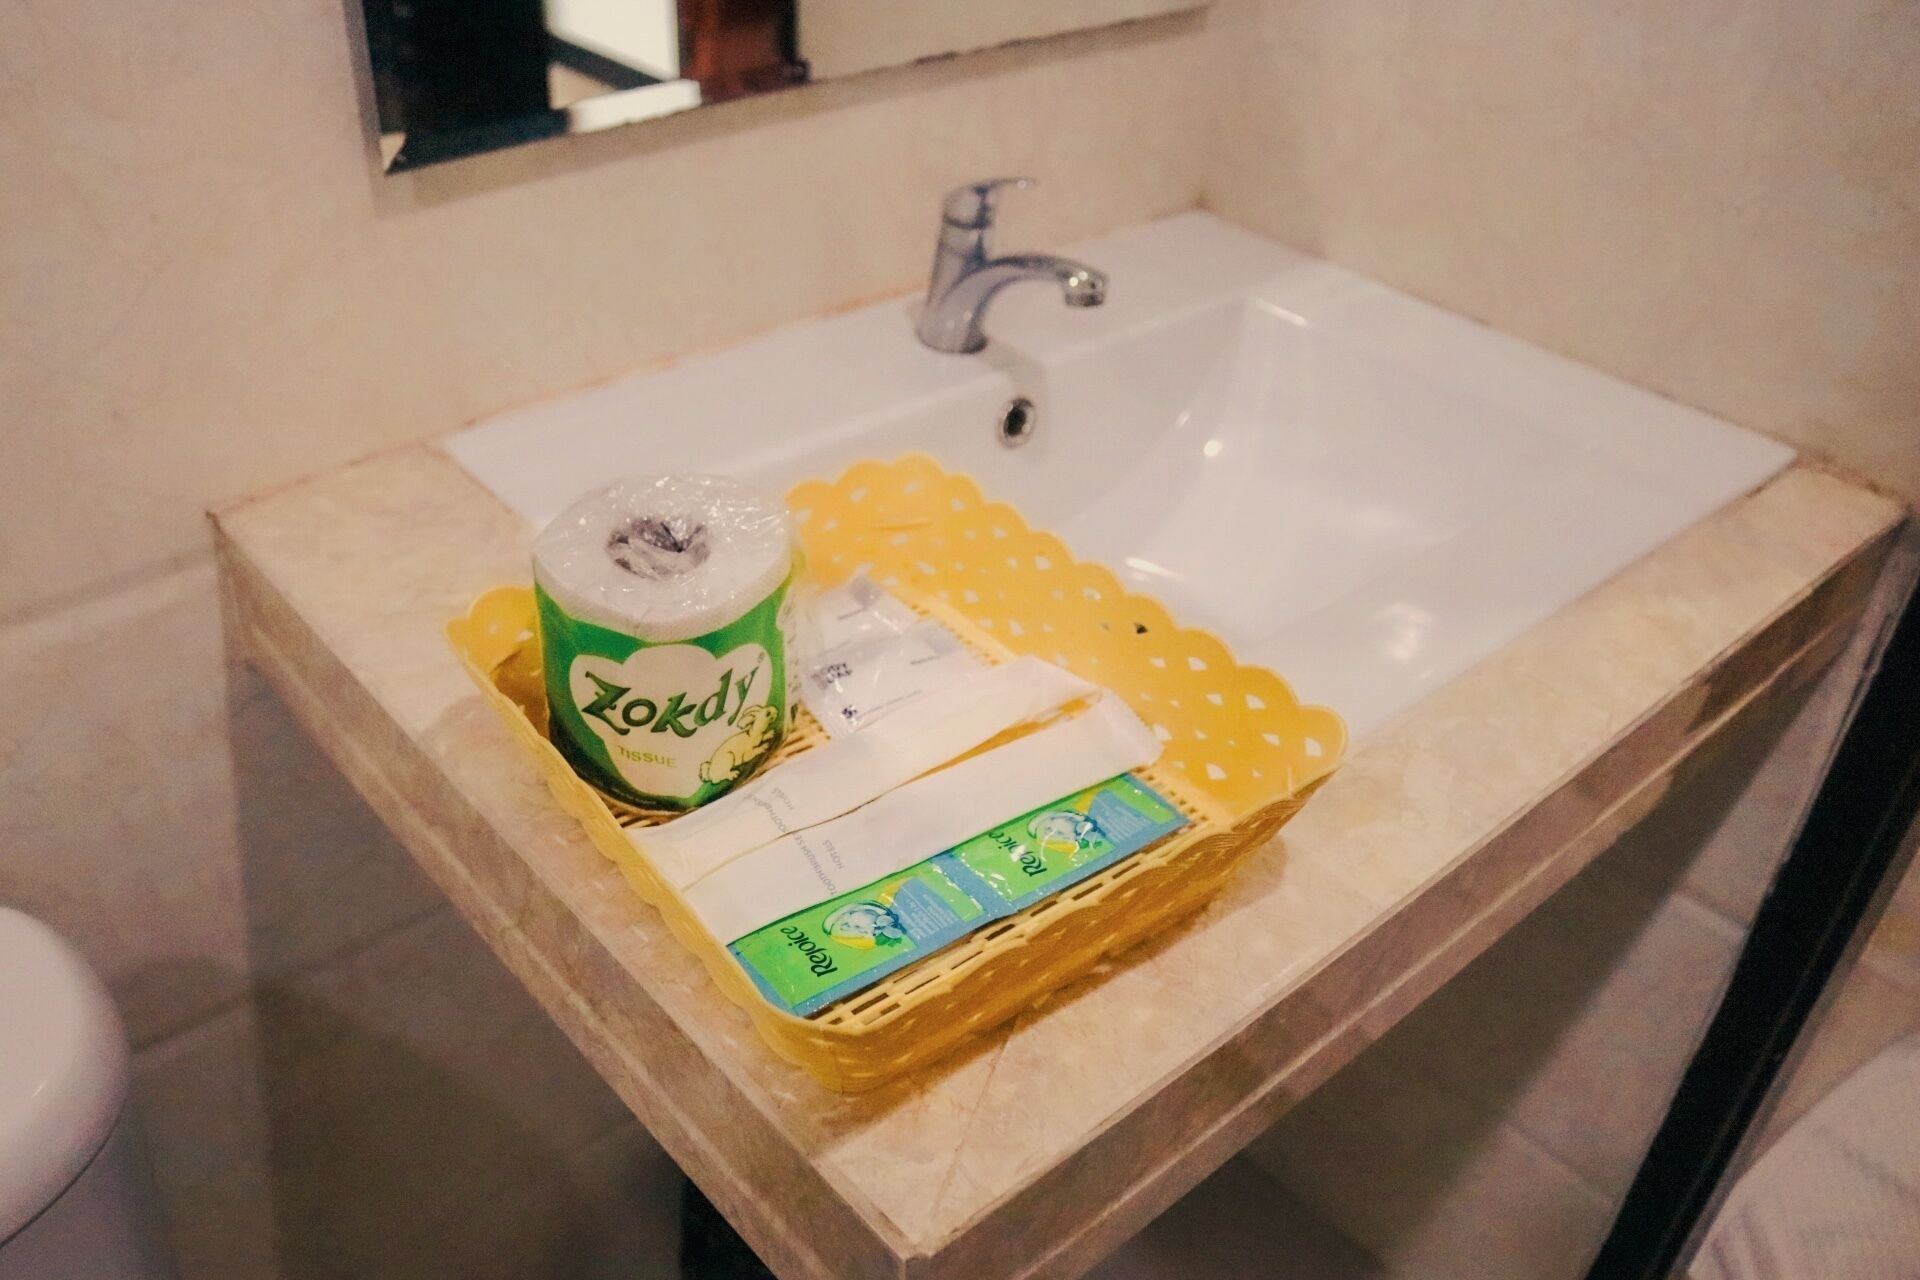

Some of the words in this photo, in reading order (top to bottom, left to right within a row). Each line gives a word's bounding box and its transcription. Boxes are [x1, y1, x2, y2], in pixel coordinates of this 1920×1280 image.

[581, 666, 760, 738] Zokdy
[617, 745, 677, 768] TISSUE
[780, 925, 838, 978] Rejoice
